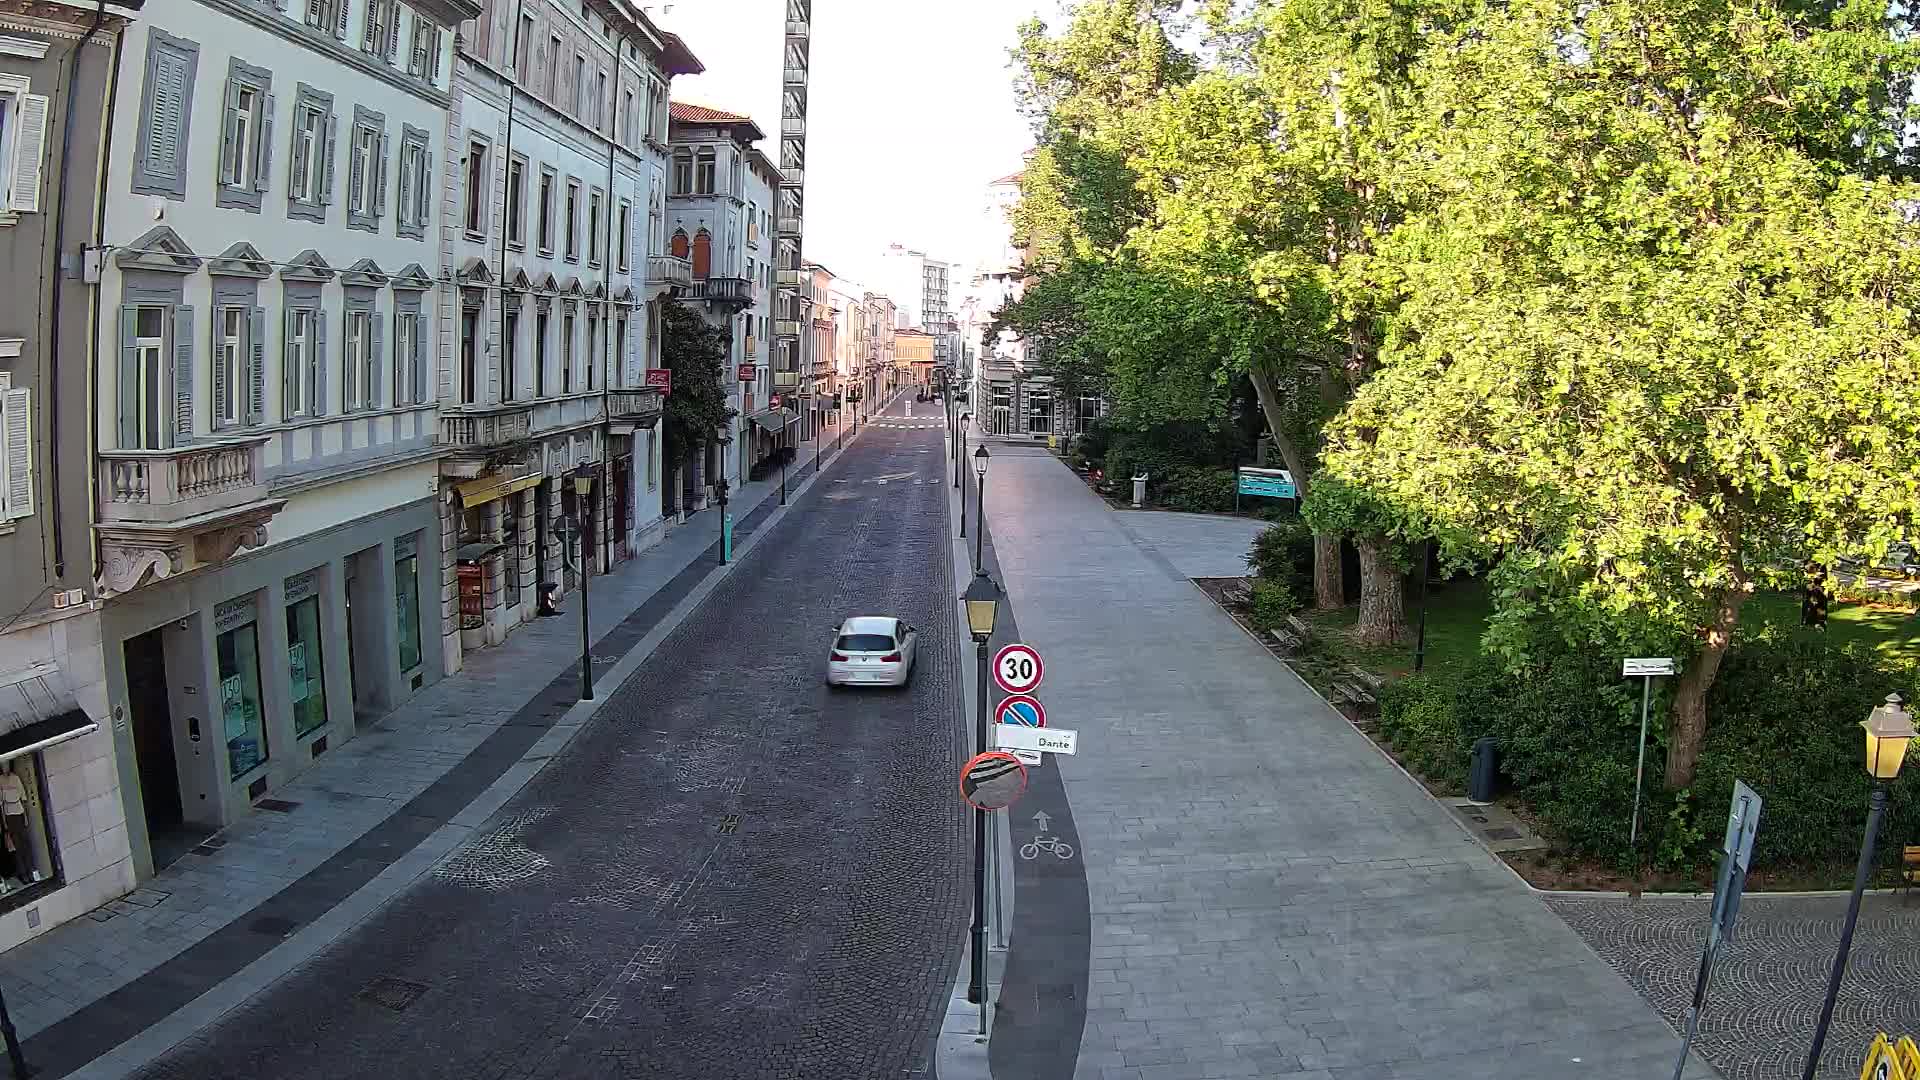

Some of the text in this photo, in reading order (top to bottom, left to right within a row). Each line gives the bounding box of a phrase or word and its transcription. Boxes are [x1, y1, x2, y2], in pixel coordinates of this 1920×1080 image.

[1005, 658, 1033, 680] 30
[222, 677, 241, 700] 130
[1039, 737, 1070, 749] Dante
